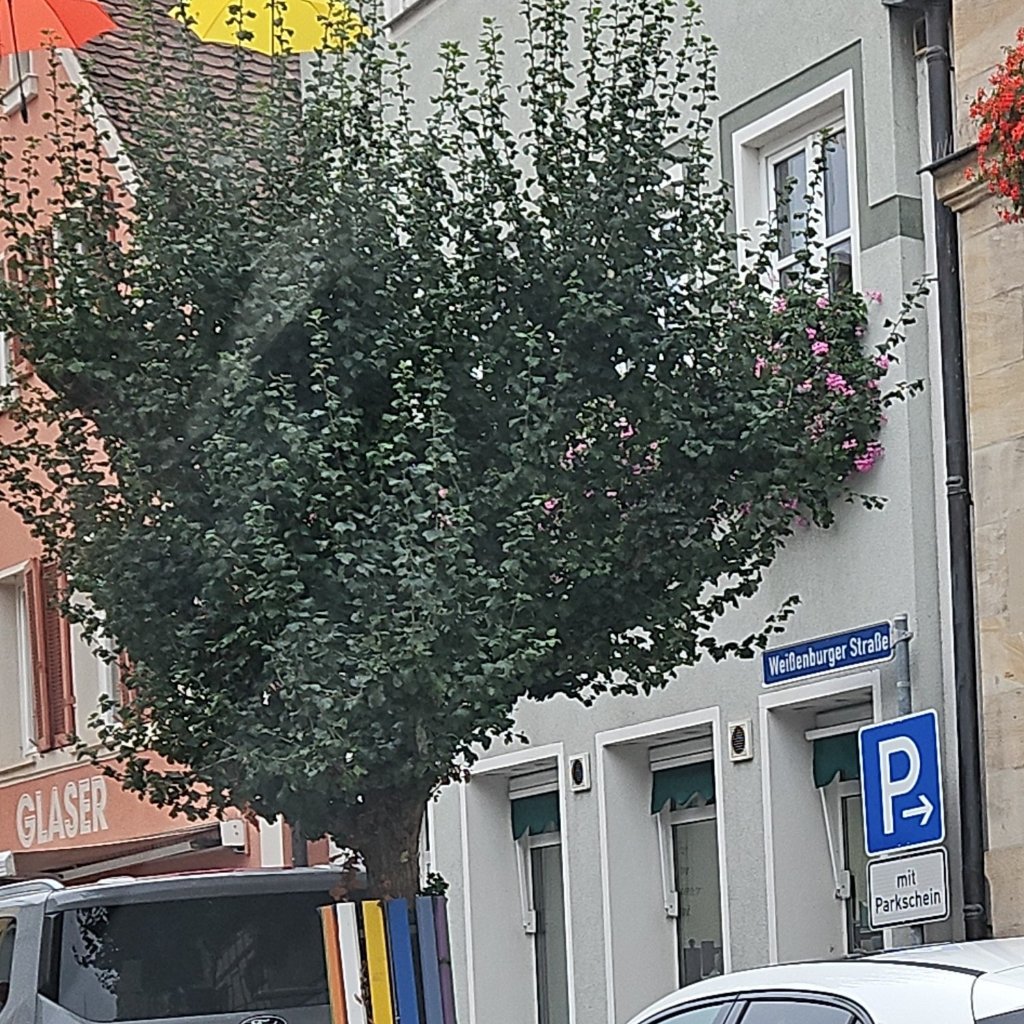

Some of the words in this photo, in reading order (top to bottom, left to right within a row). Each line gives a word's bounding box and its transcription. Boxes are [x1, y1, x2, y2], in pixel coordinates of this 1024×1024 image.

[768, 643, 848, 676] Weißenburger
[849, 631, 889, 657] Straße
[878, 736, 922, 835] P
[16, 775, 109, 849] GLASER
[875, 887, 942, 914] Parkschein
[896, 869, 916, 888] mit
